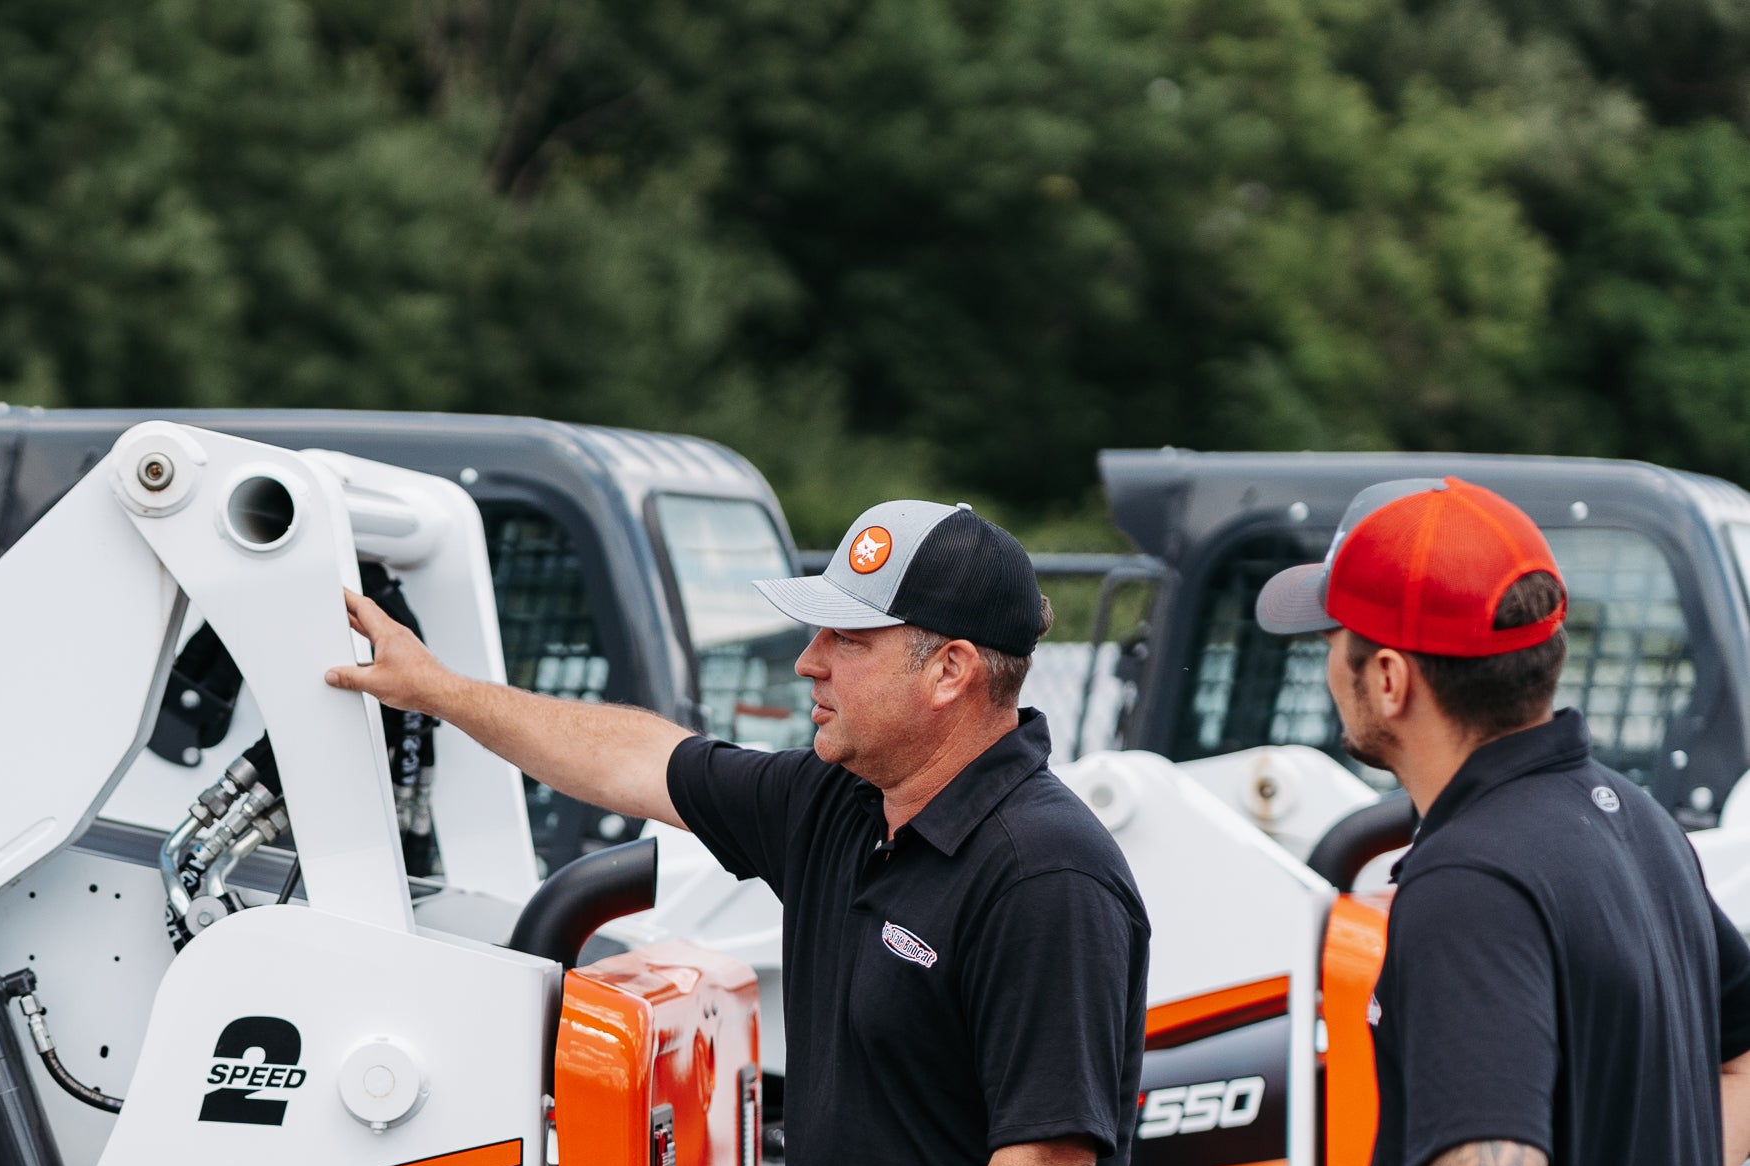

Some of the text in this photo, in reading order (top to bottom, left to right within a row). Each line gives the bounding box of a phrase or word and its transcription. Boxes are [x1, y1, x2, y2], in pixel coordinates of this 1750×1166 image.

[903, 940, 934, 964] Bobcat
[198, 1015, 302, 1127] 2
[207, 1064, 307, 1089] SPEED
[1137, 1075, 1266, 1140] 550
